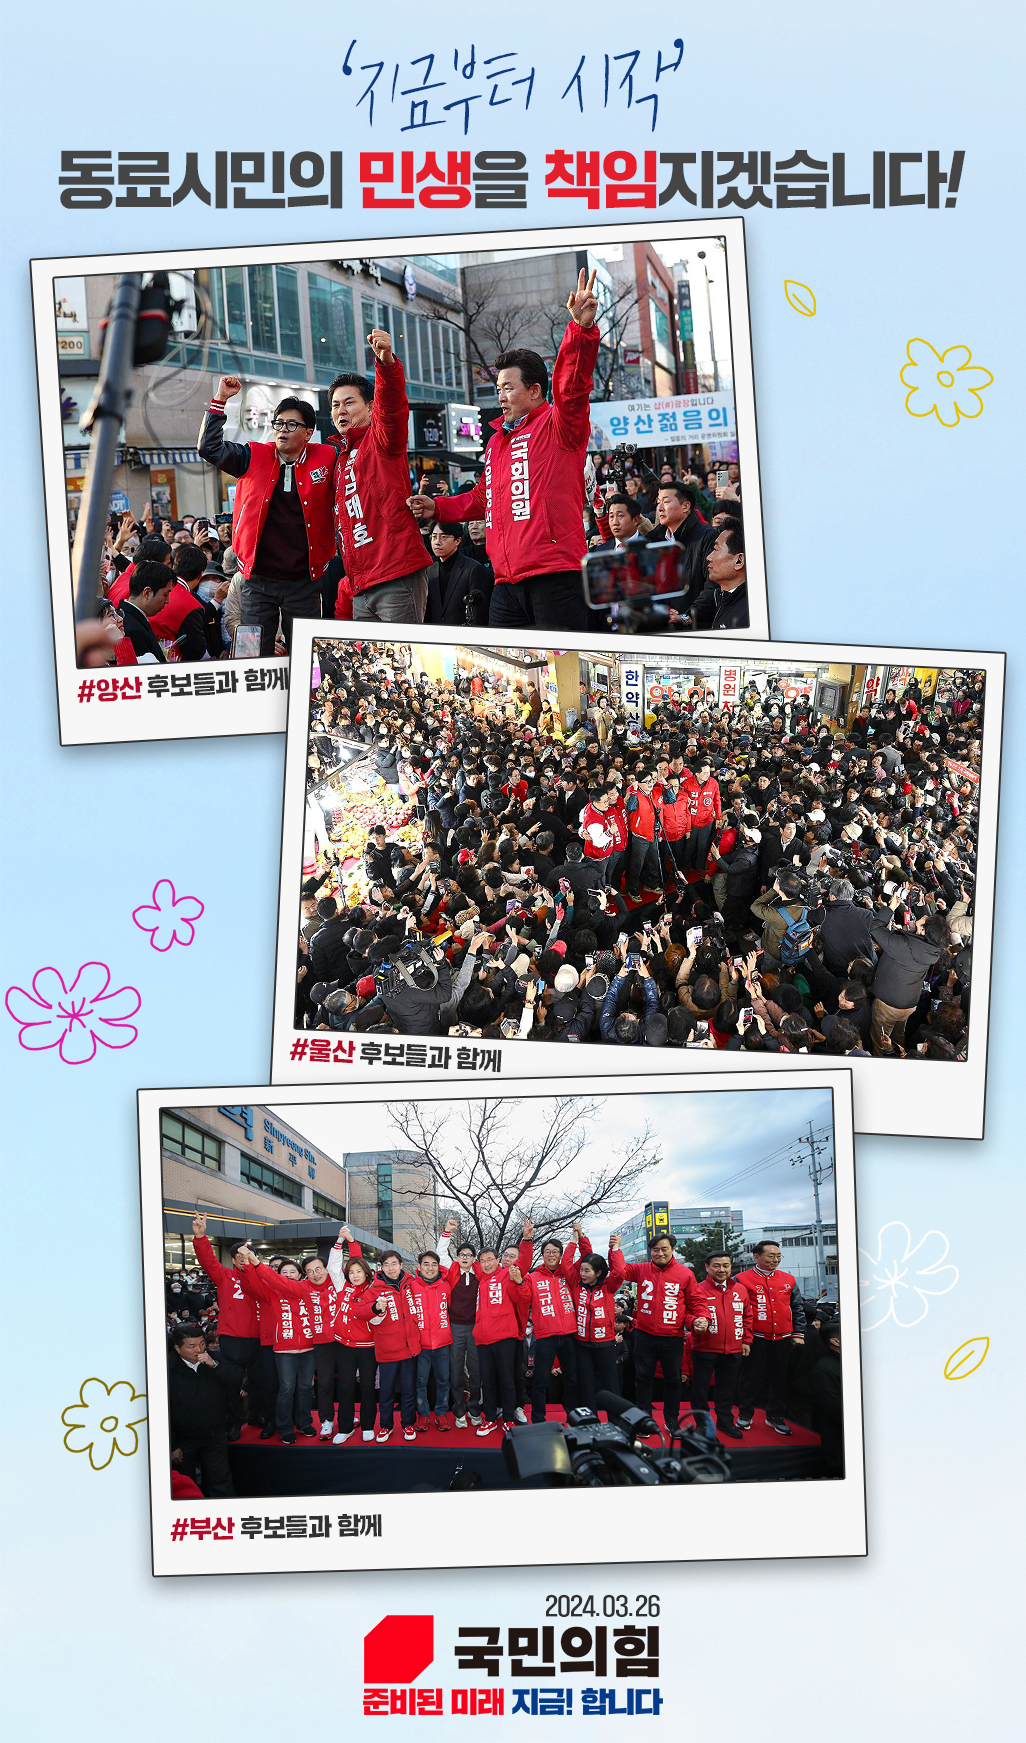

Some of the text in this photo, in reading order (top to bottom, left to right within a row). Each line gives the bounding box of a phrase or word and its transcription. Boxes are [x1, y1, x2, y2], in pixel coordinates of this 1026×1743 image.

[627, 404, 650, 412] 여기는
[510, 440, 531, 521] 국회의원
[264, 1118, 304, 1158] Sinpyeong
[233, 1283, 245, 1300] 2
[536, 1279, 556, 1318] 곽규택
[641, 1279, 654, 1301] 2
[732, 1291, 742, 1301] 2
[755, 1284, 765, 1294] 2
[593, 1289, 606, 1339] 김희정
[663, 1281, 680, 1325] 정동만
[756, 1294, 768, 1321] 김도읍
